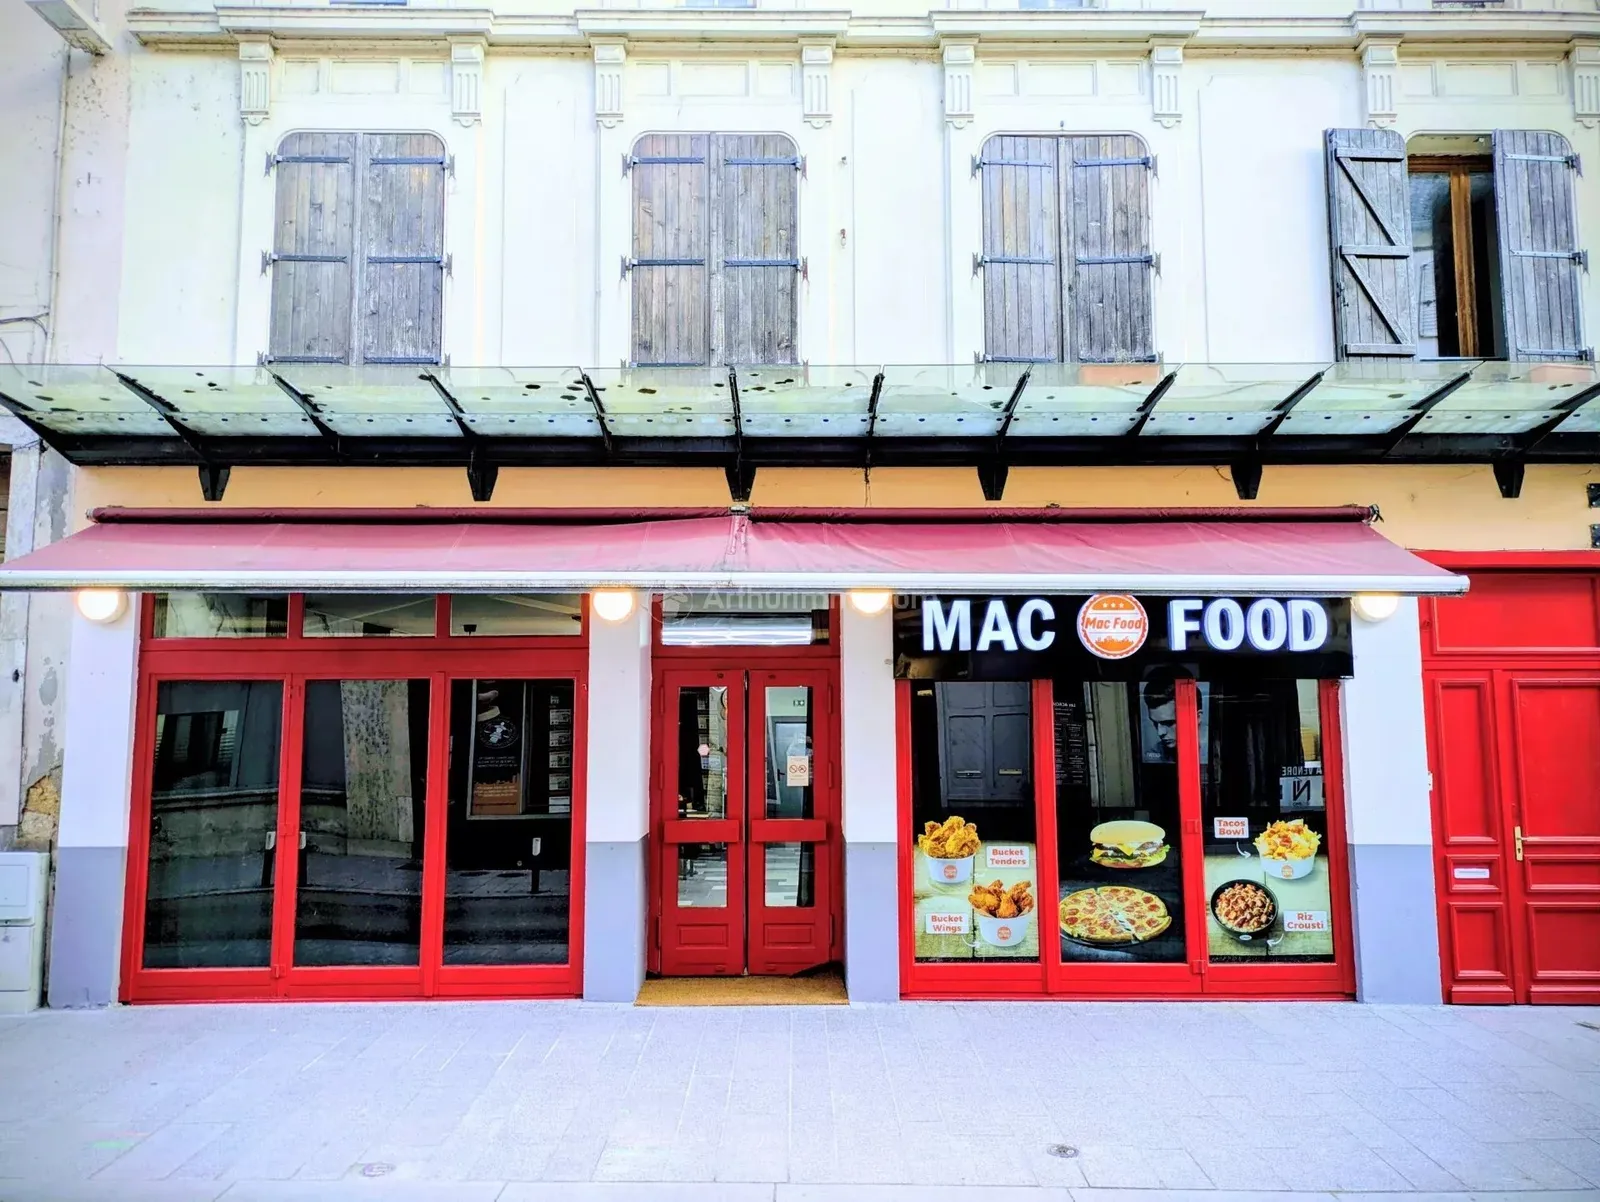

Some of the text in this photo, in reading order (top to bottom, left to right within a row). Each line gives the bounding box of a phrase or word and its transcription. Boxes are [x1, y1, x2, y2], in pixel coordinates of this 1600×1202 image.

[922, 597, 1329, 651] MAC FOOD
[1084, 616, 1143, 629] Mac Food
[1219, 828, 1245, 836] Bowl
[992, 848, 1024, 856] Bucket
[931, 915, 963, 923] Bucket
[1297, 912, 1313, 920] Riz
[933, 924, 962, 933] Wings
[1287, 921, 1324, 929] Crousti
